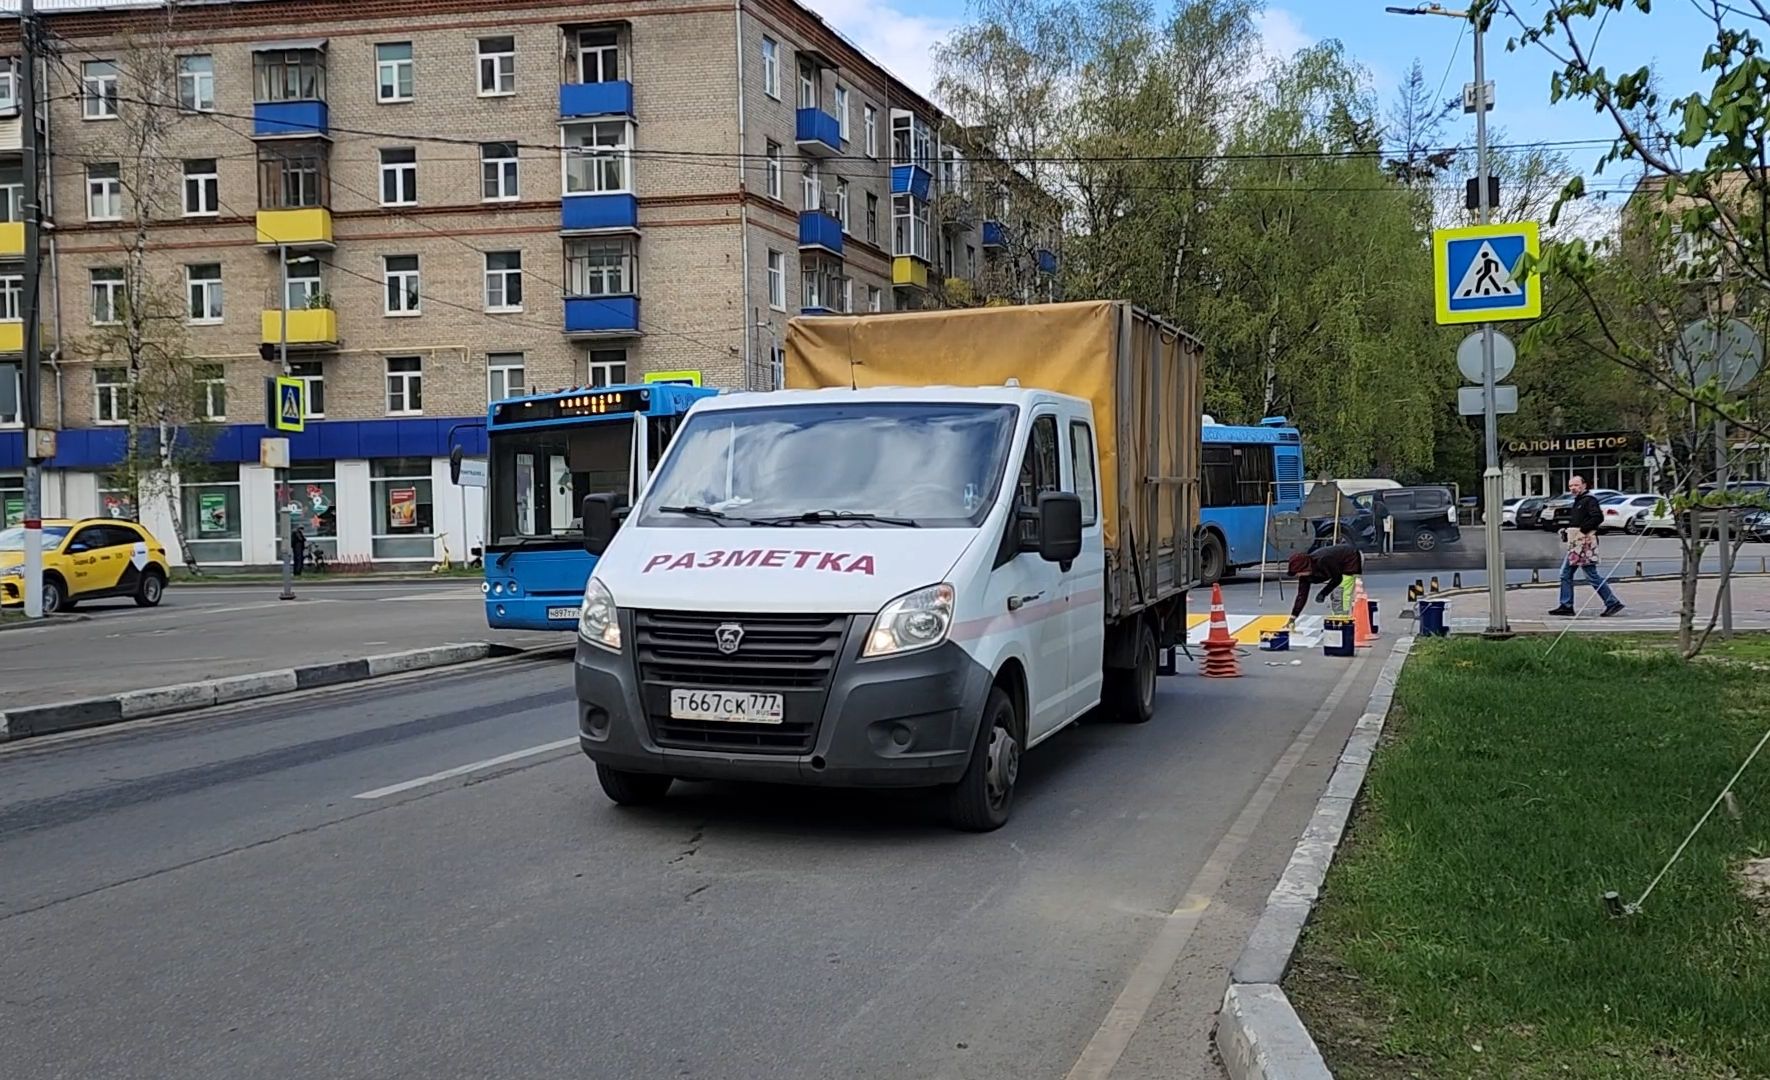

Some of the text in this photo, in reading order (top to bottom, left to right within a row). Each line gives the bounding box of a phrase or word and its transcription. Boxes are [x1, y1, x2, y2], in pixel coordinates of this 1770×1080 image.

[1508, 439, 1560, 452] САЛОН
[642, 549, 875, 576] РАЗМЕТКА
[749, 694, 778, 713] 777
